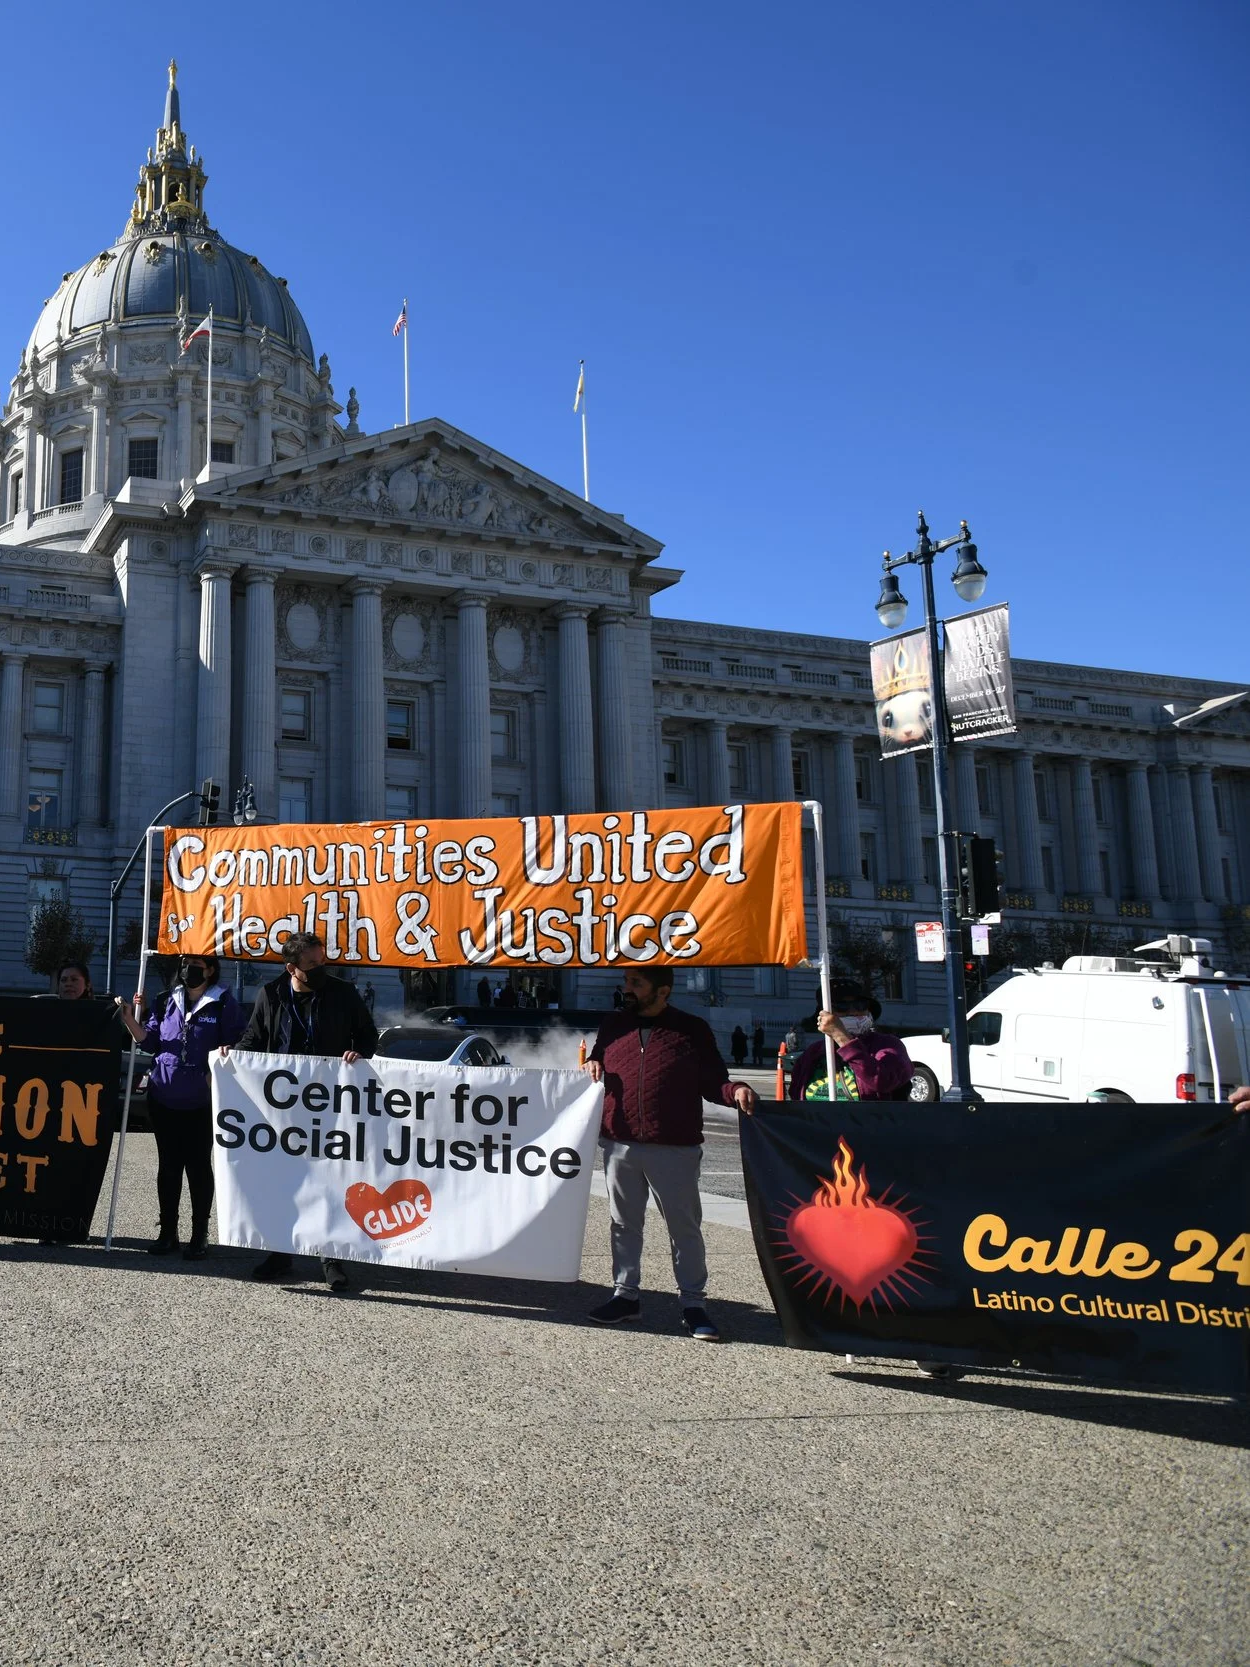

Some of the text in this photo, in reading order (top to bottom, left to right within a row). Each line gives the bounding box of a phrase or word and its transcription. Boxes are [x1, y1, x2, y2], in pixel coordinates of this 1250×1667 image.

[949, 651, 1006, 673] A BATTLE
[168, 805, 746, 893] Communities United
[166, 887, 702, 965] for Health & Justice
[263, 1069, 529, 1127] Center for
[215, 1109, 582, 1180] Social Justice
[3, 1209, 90, 1232] MISSION
[363, 1194, 431, 1234] GLIDE
[379, 1226, 433, 1250] UNCONDITIONALLY
[963, 1213, 1250, 1286] Calle 24
[972, 1288, 1250, 1329] Latino Cultural Distri
